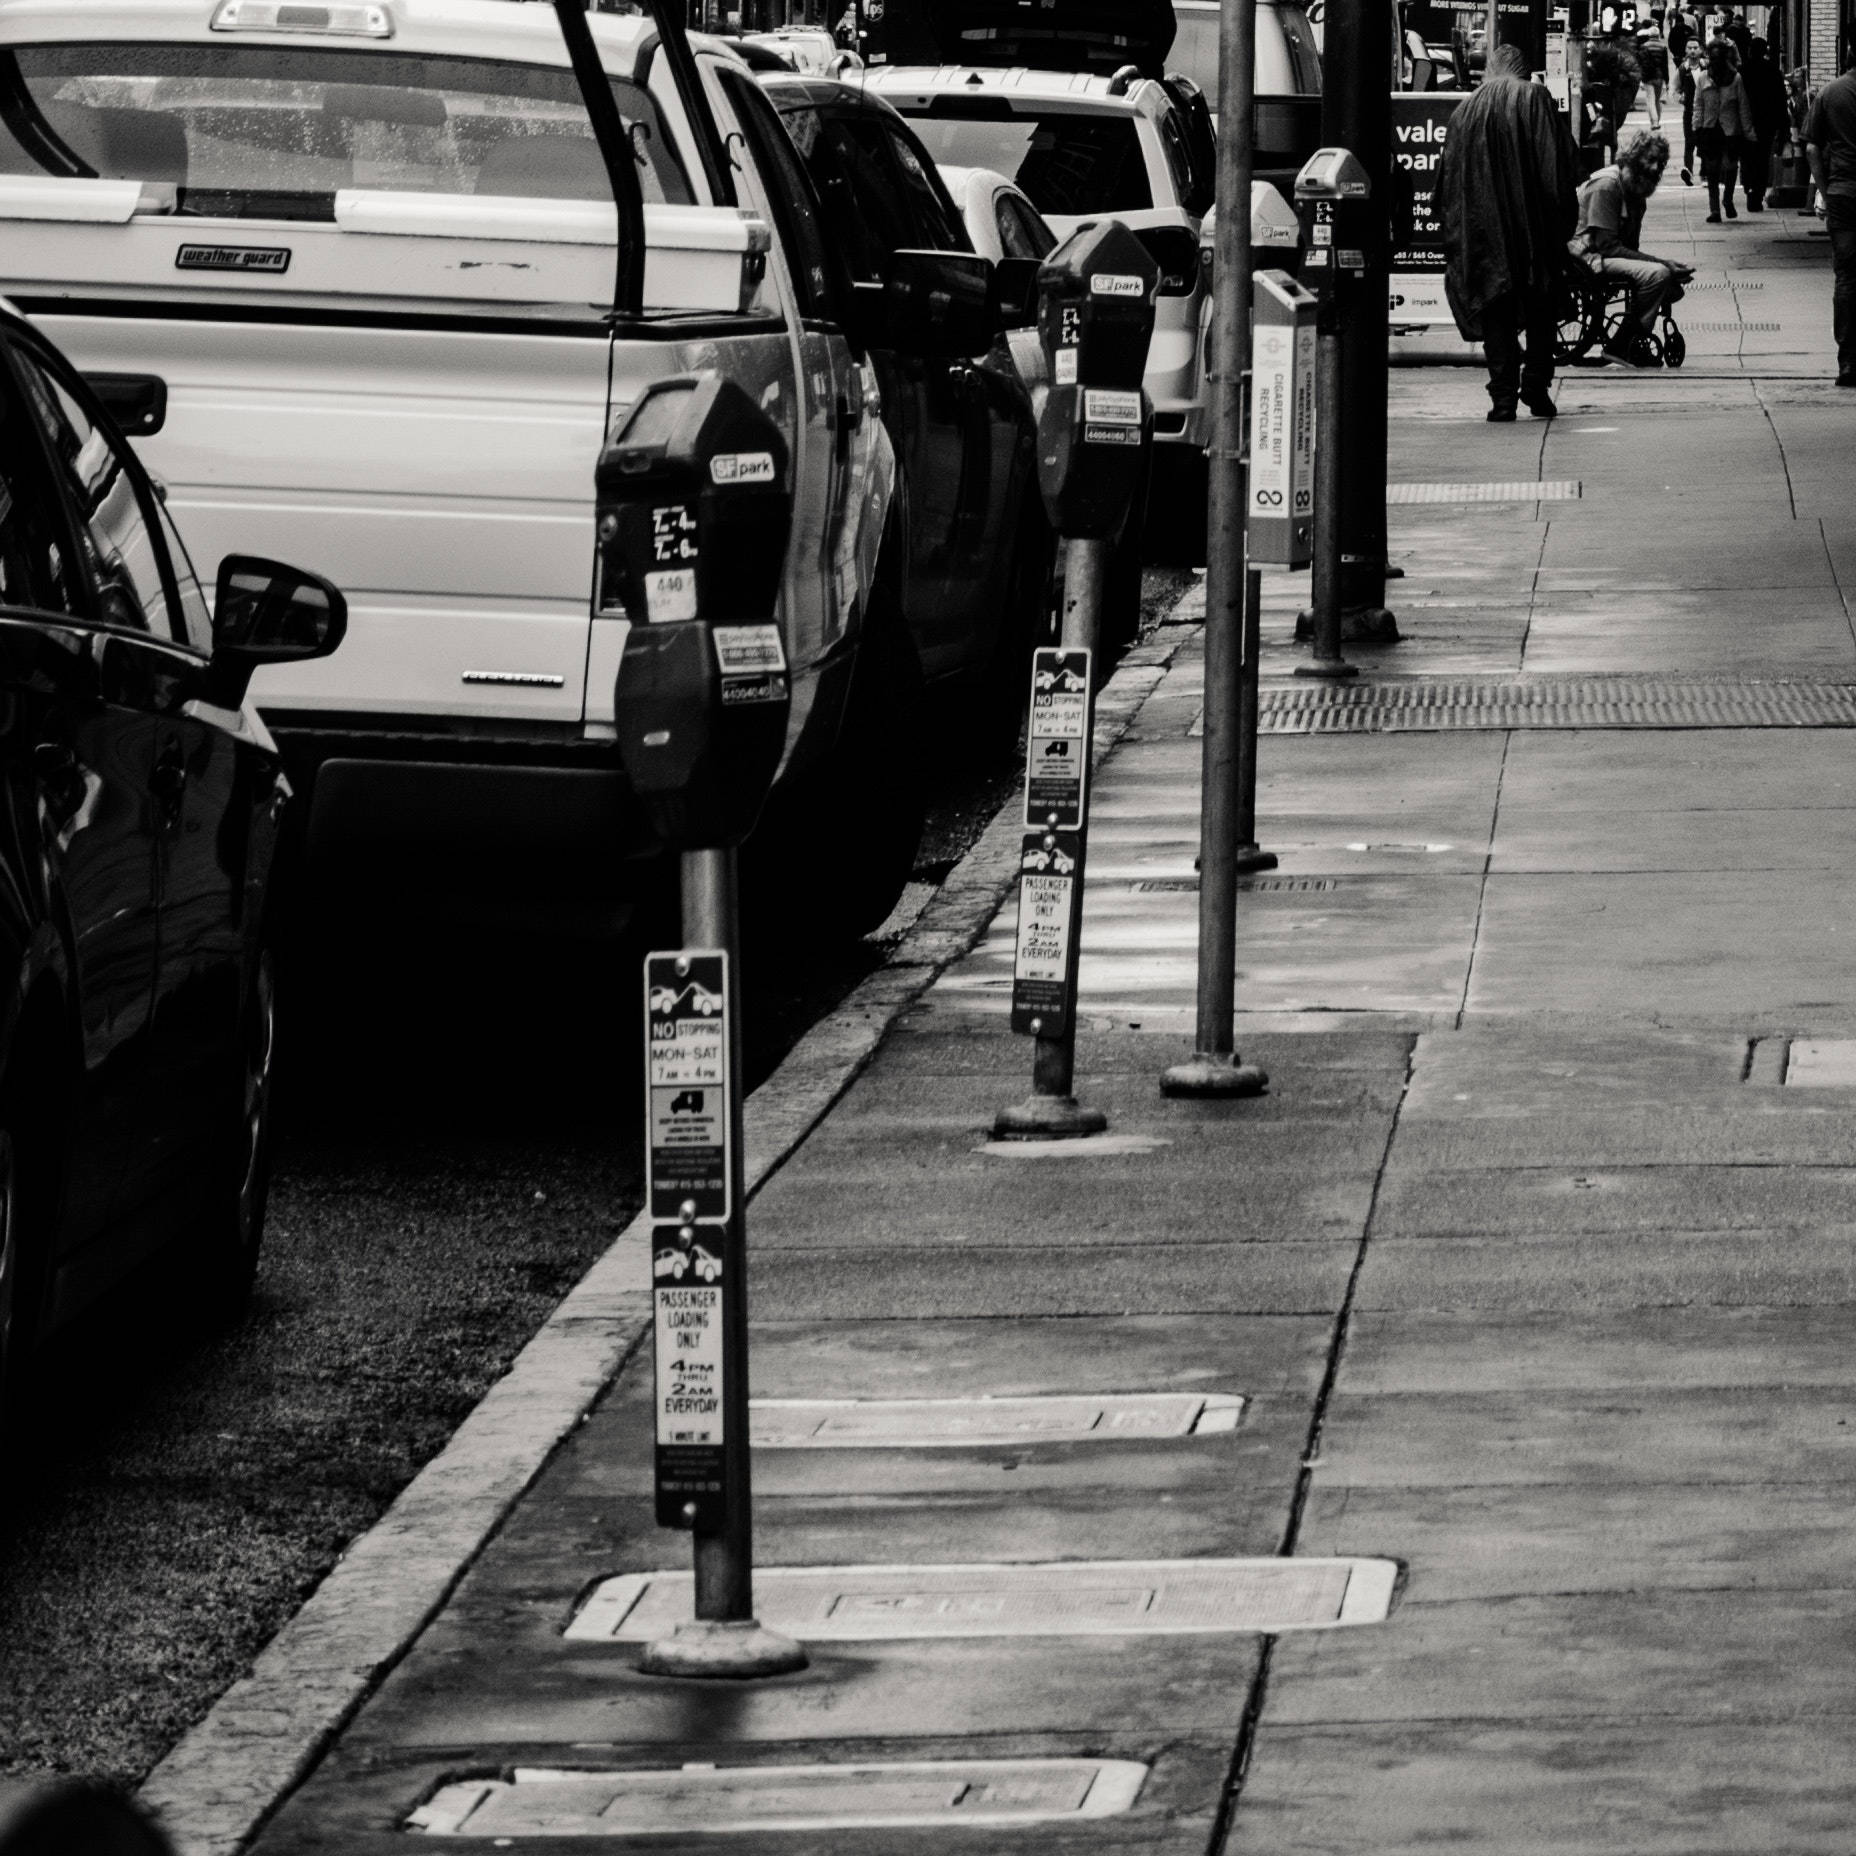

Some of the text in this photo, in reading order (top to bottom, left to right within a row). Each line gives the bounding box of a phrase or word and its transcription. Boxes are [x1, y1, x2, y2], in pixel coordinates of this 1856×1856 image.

[183, 248, 283, 265] weather guard
[1259, 388, 1270, 450] RECYCLING
[1272, 373, 1284, 466] CIGARETTE BUTT
[1026, 878, 1067, 890] PASSENGER
[1030, 891, 1061, 903] LOADING
[1035, 905, 1053, 916] ONLY
[1022, 948, 1062, 959] EVERYDAY
[653, 1022, 721, 1038] NO STOPPING
[660, 1291, 716, 1308] PASSENGER
[668, 1312, 709, 1329] LOADING
[677, 1331, 700, 1349] ONLY
[665, 1398, 718, 1414] EVERYDAY
